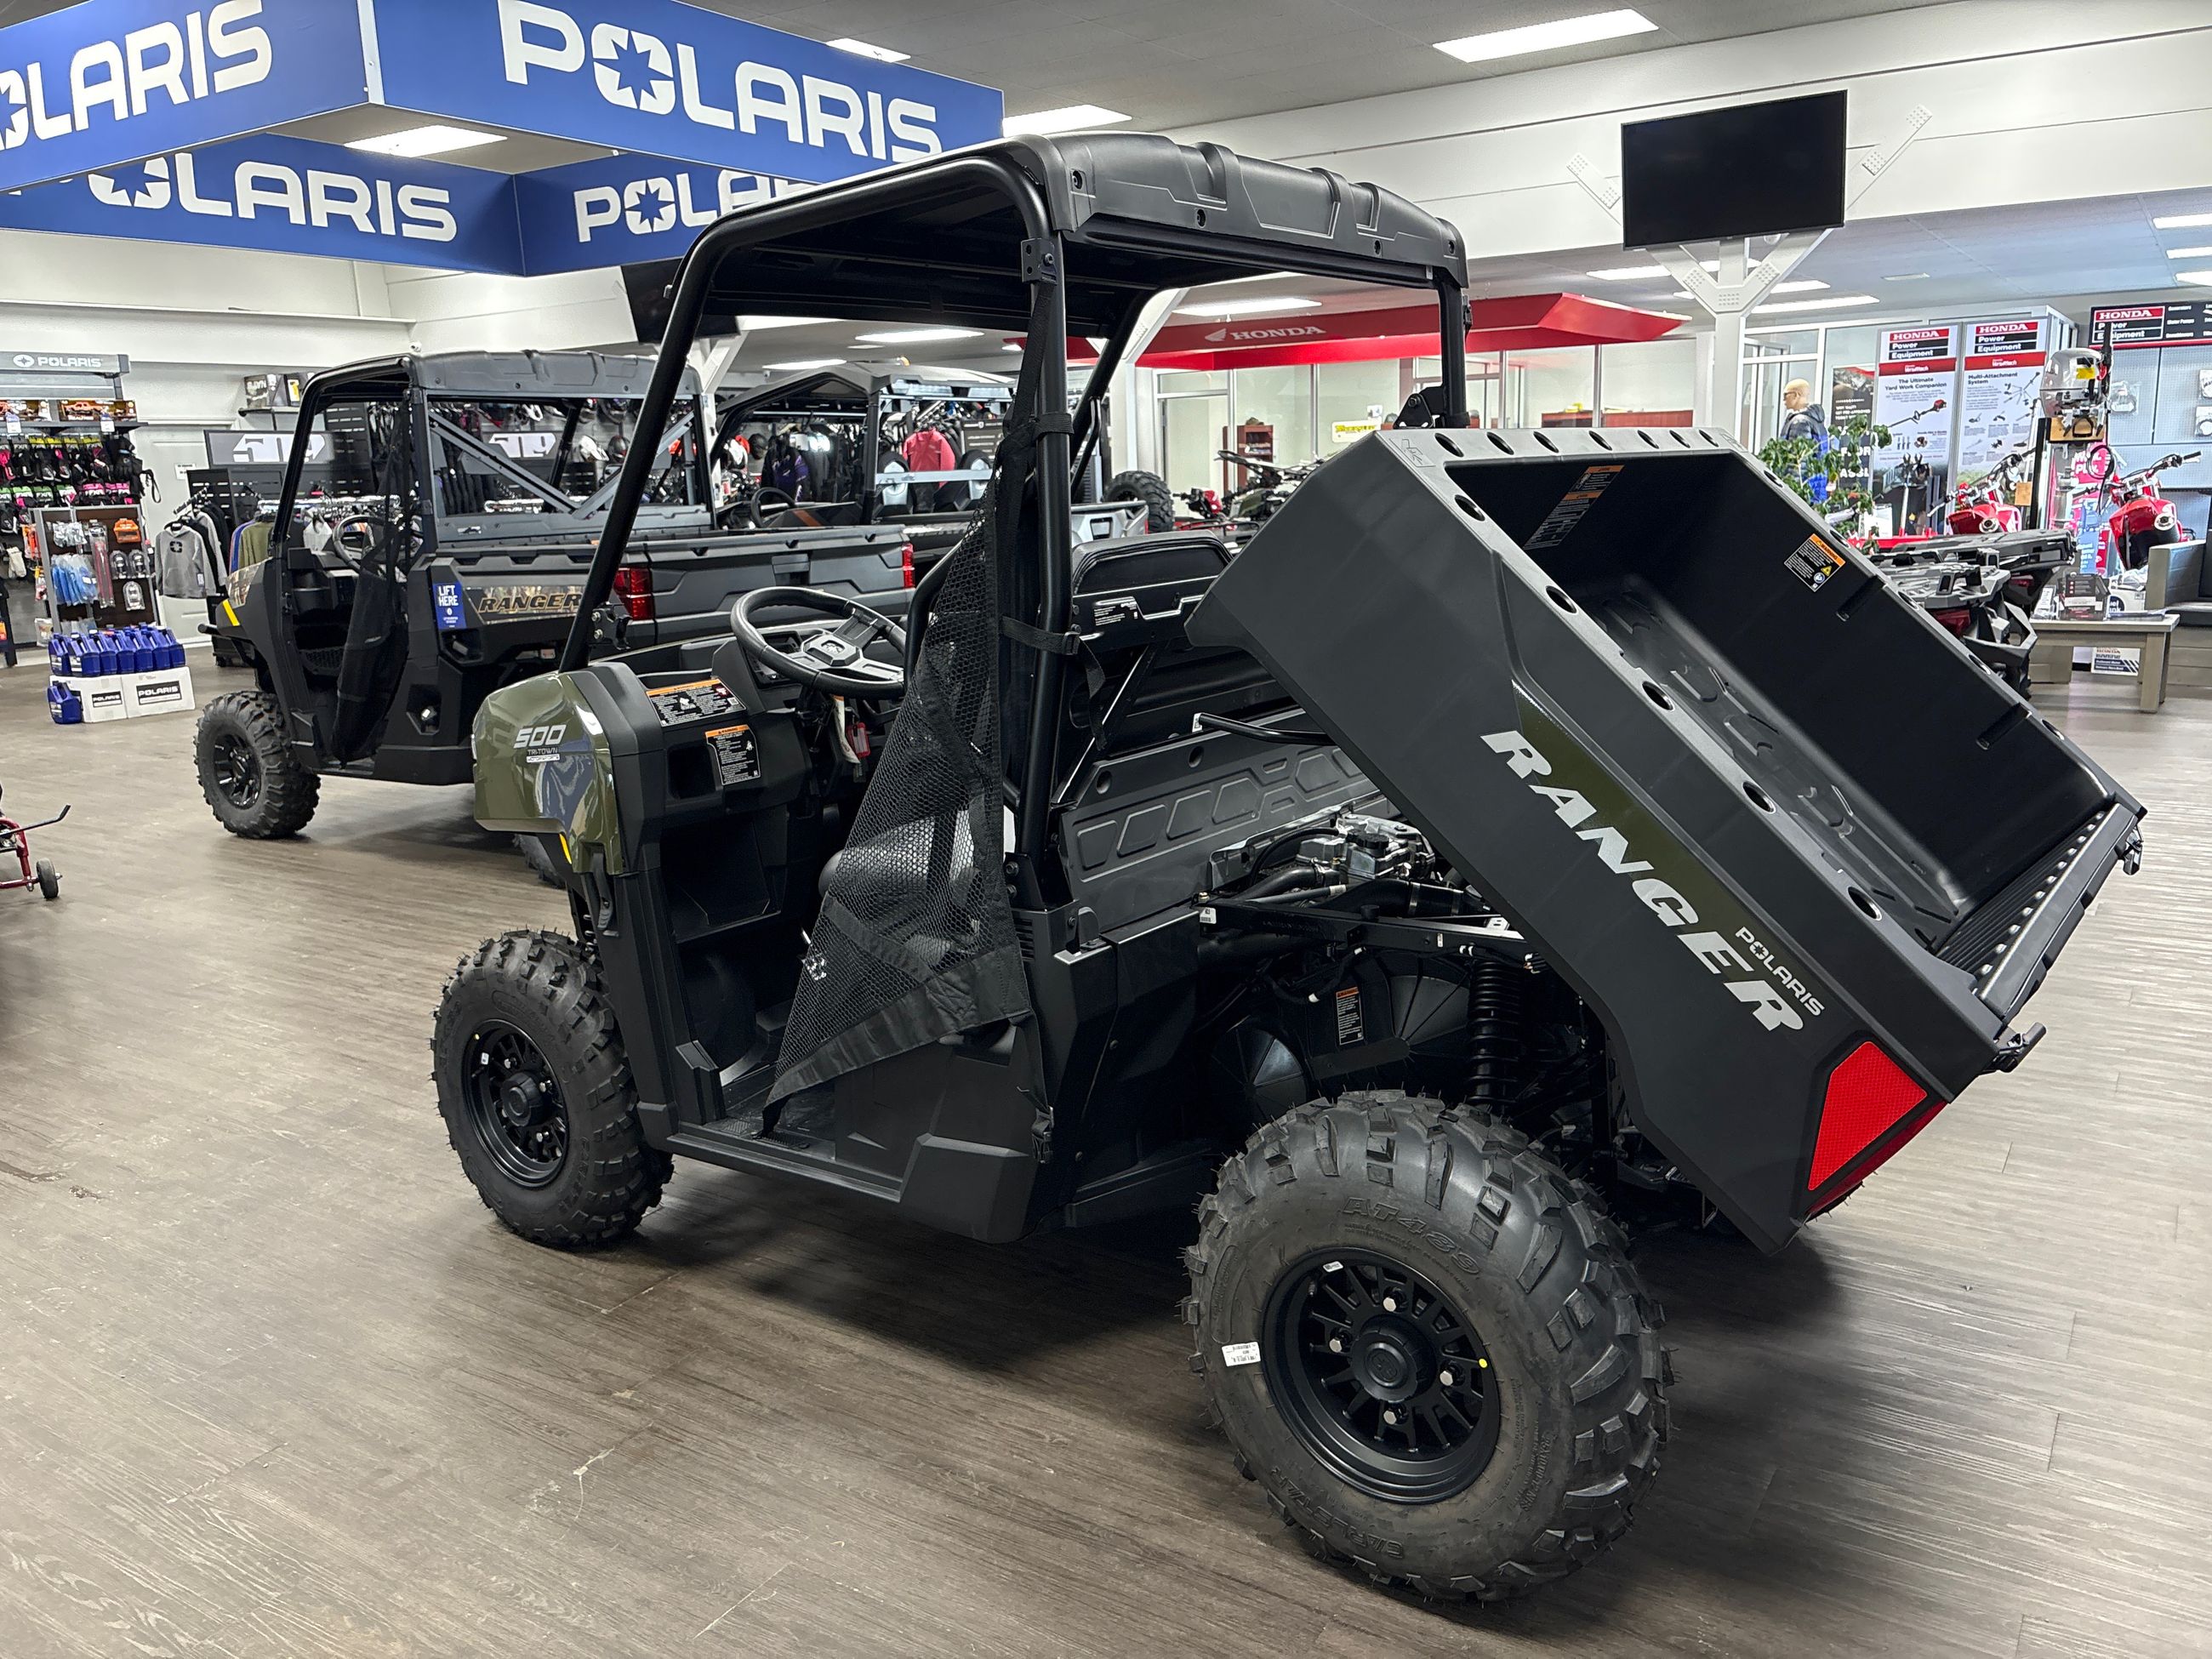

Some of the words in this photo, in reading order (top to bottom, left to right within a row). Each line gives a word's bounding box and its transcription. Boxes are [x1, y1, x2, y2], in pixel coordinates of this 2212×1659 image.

[498, 0, 942, 162] POLARIS
[88, 152, 458, 242] OLARIS
[2099, 310, 2152, 320] HONDA
[1230, 326, 1326, 340] HONDA
[1980, 322, 2028, 333] HONDA
[1893, 330, 1940, 341] HONDA
[1891, 342, 1918, 351] Power
[1977, 343, 2021, 353] Equipment
[1891, 350, 1934, 360] Equipment
[37, 356, 102, 368] POLARIS
[438, 585, 455, 596] LIFT
[439, 596, 459, 607] HERE
[478, 593, 583, 613] RANGER
[139, 686, 179, 697] POLARIS
[513, 724, 567, 749] 500
[528, 747, 558, 755] TRI-TOWN
[1480, 730, 1804, 1031] RANGER
[1735, 926, 1826, 1017] POLARIS
